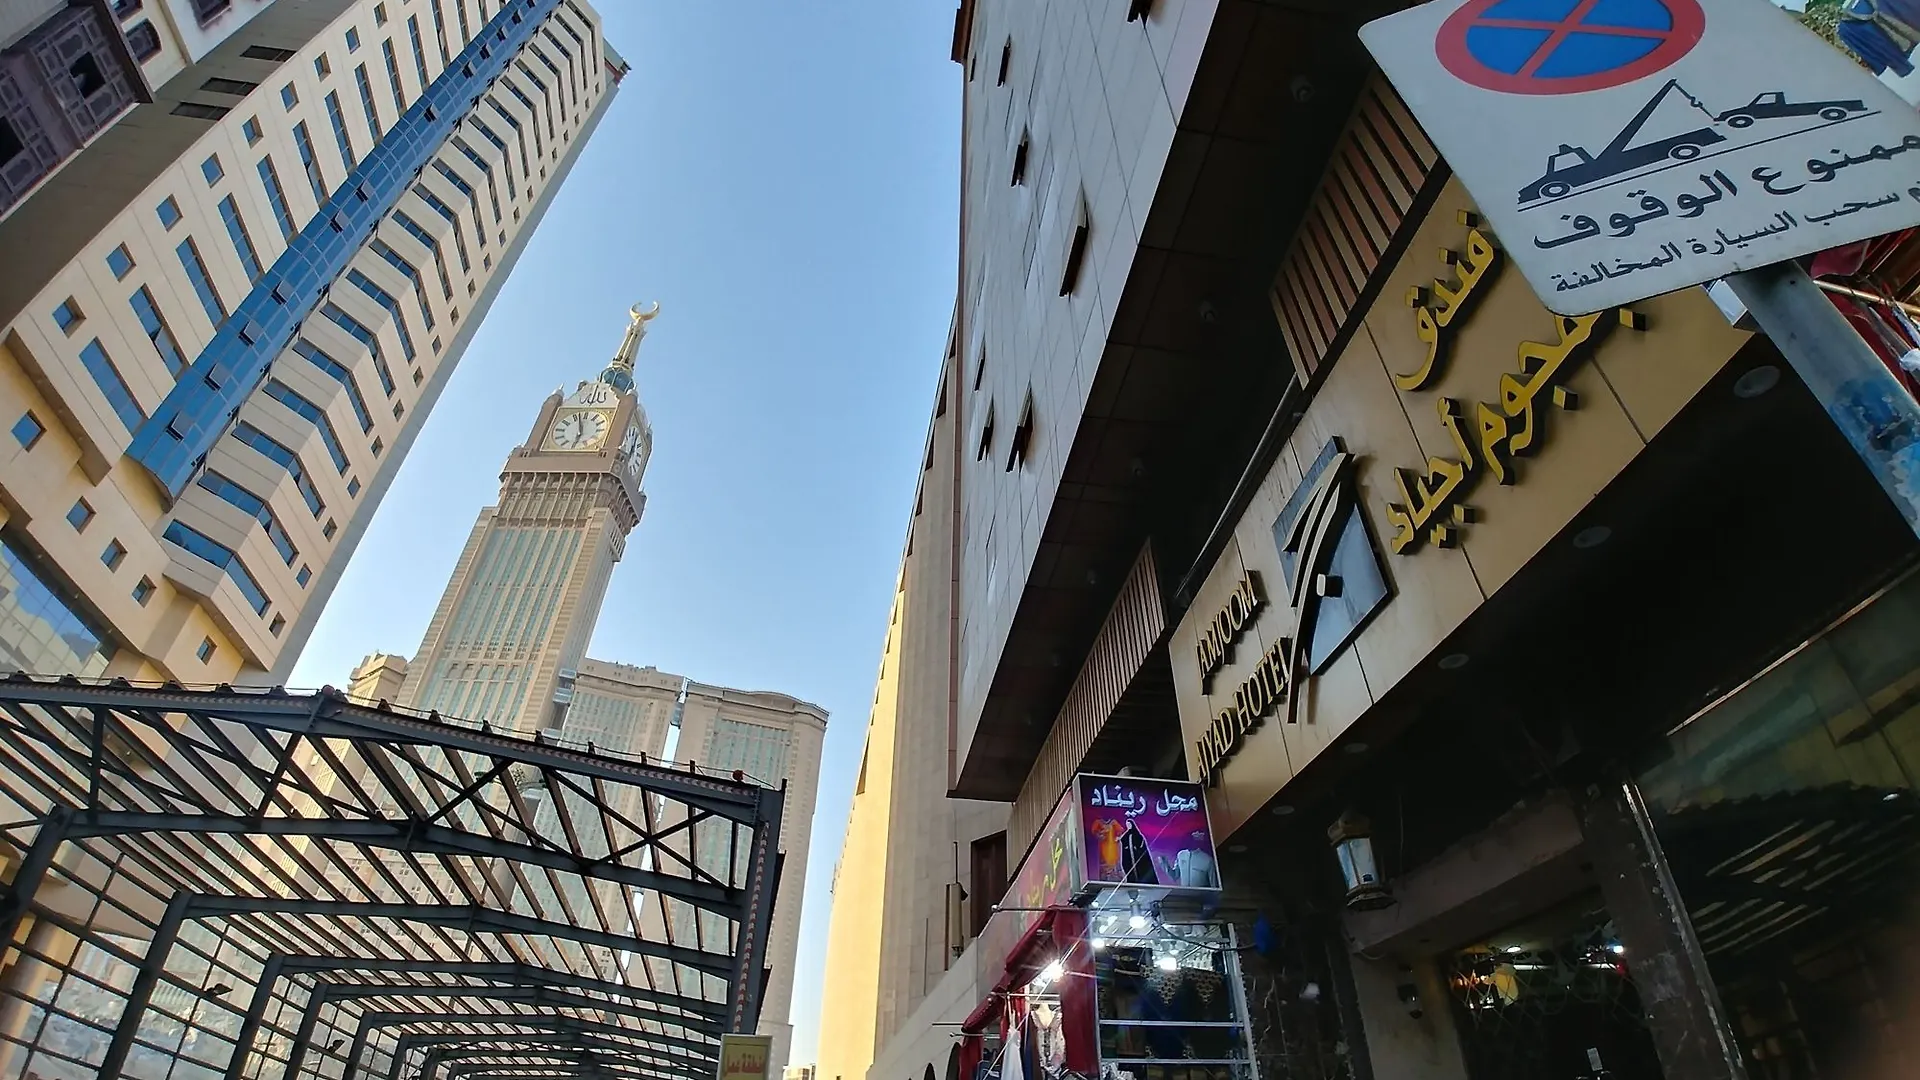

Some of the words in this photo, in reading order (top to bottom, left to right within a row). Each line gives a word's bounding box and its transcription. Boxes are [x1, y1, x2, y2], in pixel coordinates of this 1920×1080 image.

[1752, 134, 1920, 196] ممنوع
[1533, 169, 1738, 250] الوقوف
[1691, 210, 1798, 256] السيارة
[1803, 192, 1900, 226] سحب
[1555, 241, 1682, 292] المخالفة
[1395, 207, 1496, 391] فندق
[1477, 307, 1634, 485] مجوم
[1385, 397, 1474, 555] أجياد
[1196, 707, 1234, 788] AJYAD
[1091, 784, 1147, 818] ريناد
[1155, 787, 1199, 817] محل
